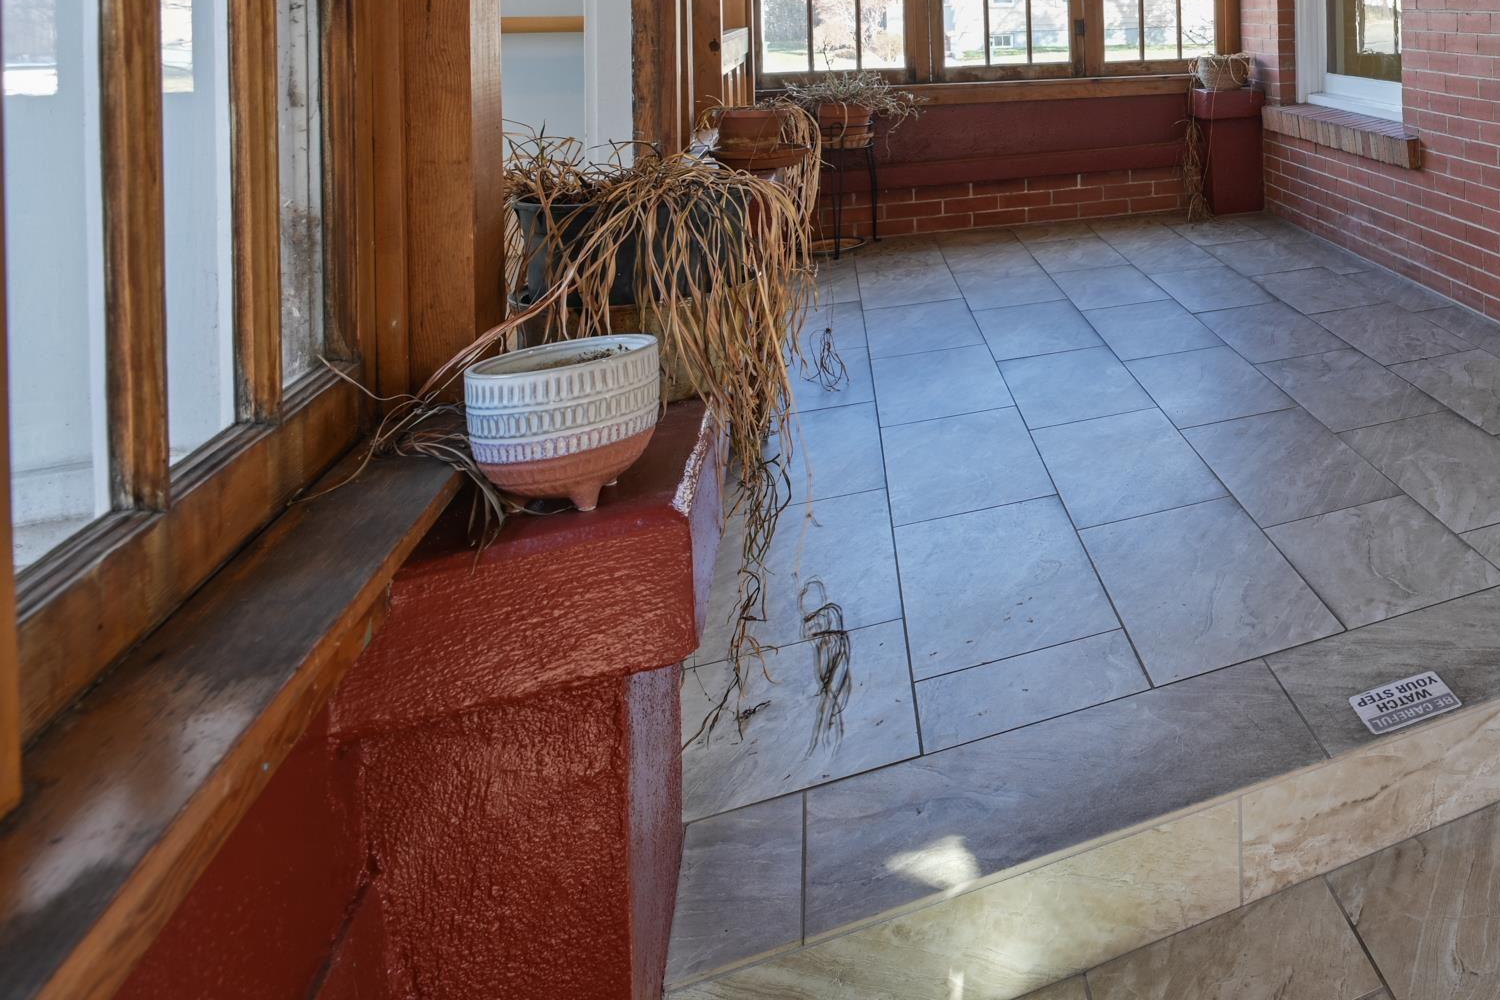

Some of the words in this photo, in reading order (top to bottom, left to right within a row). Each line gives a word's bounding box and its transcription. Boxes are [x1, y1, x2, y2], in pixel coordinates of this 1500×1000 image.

[1395, 676, 1438, 693] YOUR
[1357, 689, 1394, 708] STEP
[1377, 689, 1432, 712] WATCH
[1437, 696, 1454, 707] BE
[1372, 703, 1434, 728] CAREFUL
